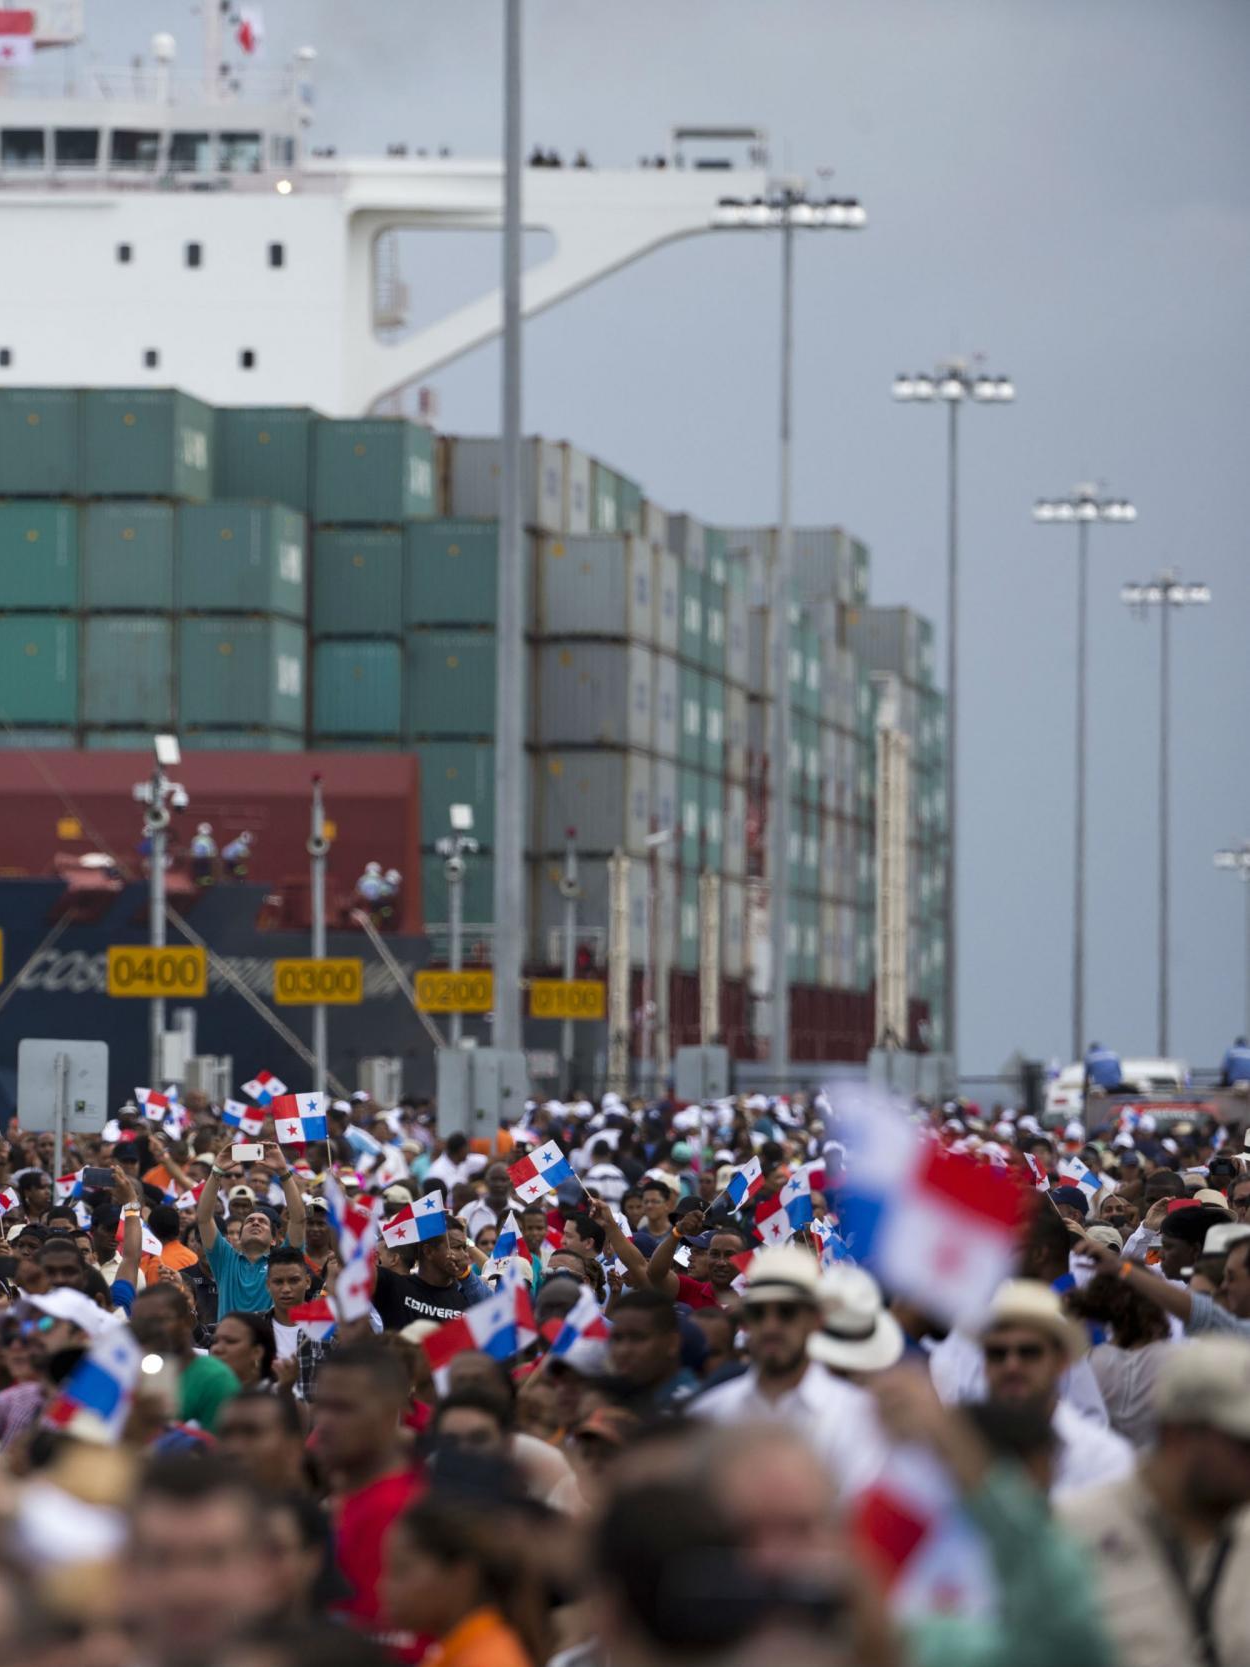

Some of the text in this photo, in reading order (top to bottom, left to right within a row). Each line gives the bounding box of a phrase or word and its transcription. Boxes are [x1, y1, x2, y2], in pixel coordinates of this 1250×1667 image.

[113, 954, 199, 988] 0400
[279, 964, 358, 997] 0300
[418, 976, 488, 1005] 0200
